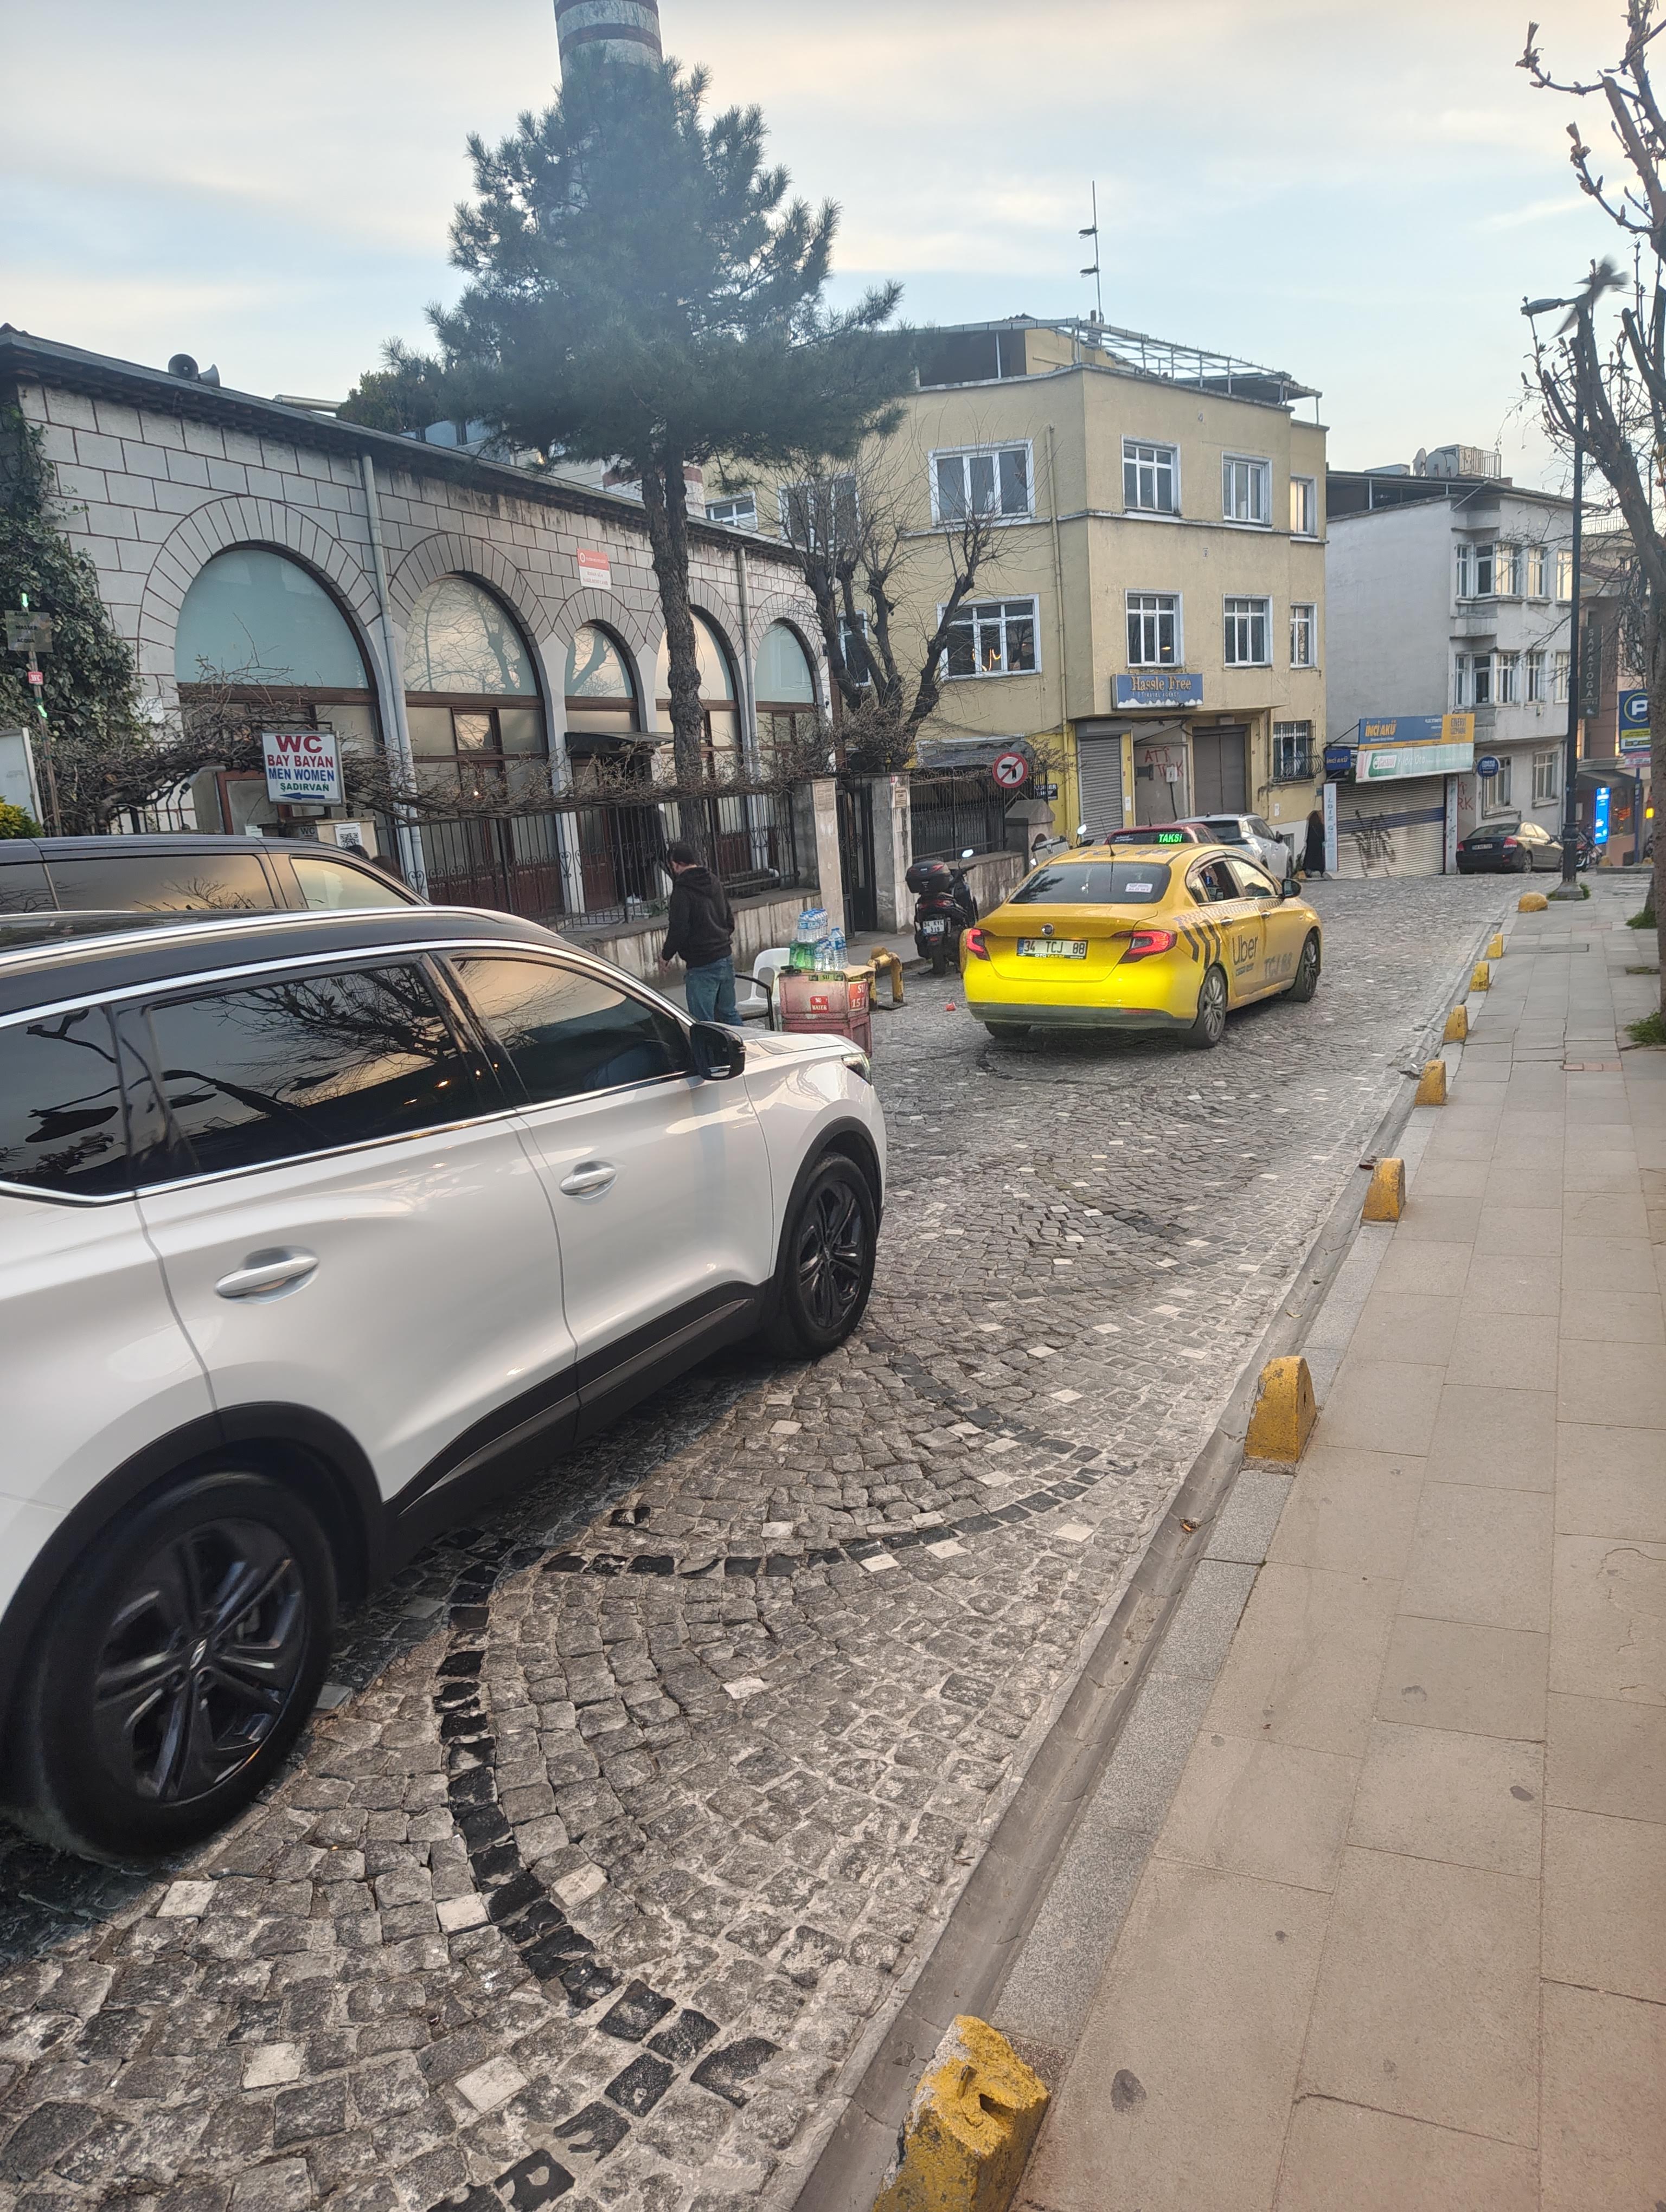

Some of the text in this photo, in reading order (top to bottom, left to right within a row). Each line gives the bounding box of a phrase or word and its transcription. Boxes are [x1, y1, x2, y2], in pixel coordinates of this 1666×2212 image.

[1131, 676, 1192, 691] Hassle Free
[1631, 699, 1648, 716] P
[275, 735, 323, 754] WC
[267, 754, 334, 768] BAY BAYAN
[268, 767, 335, 781] MEN WOMEN
[280, 782, 329, 792] ŞADIRVAN
[300, 827, 316, 835] WC
[1024, 940, 1086, 954] 34 TCJ 88
[1232, 935, 1259, 965] Uber
[857, 983, 866, 994] SU
[851, 998, 860, 1008] 15
